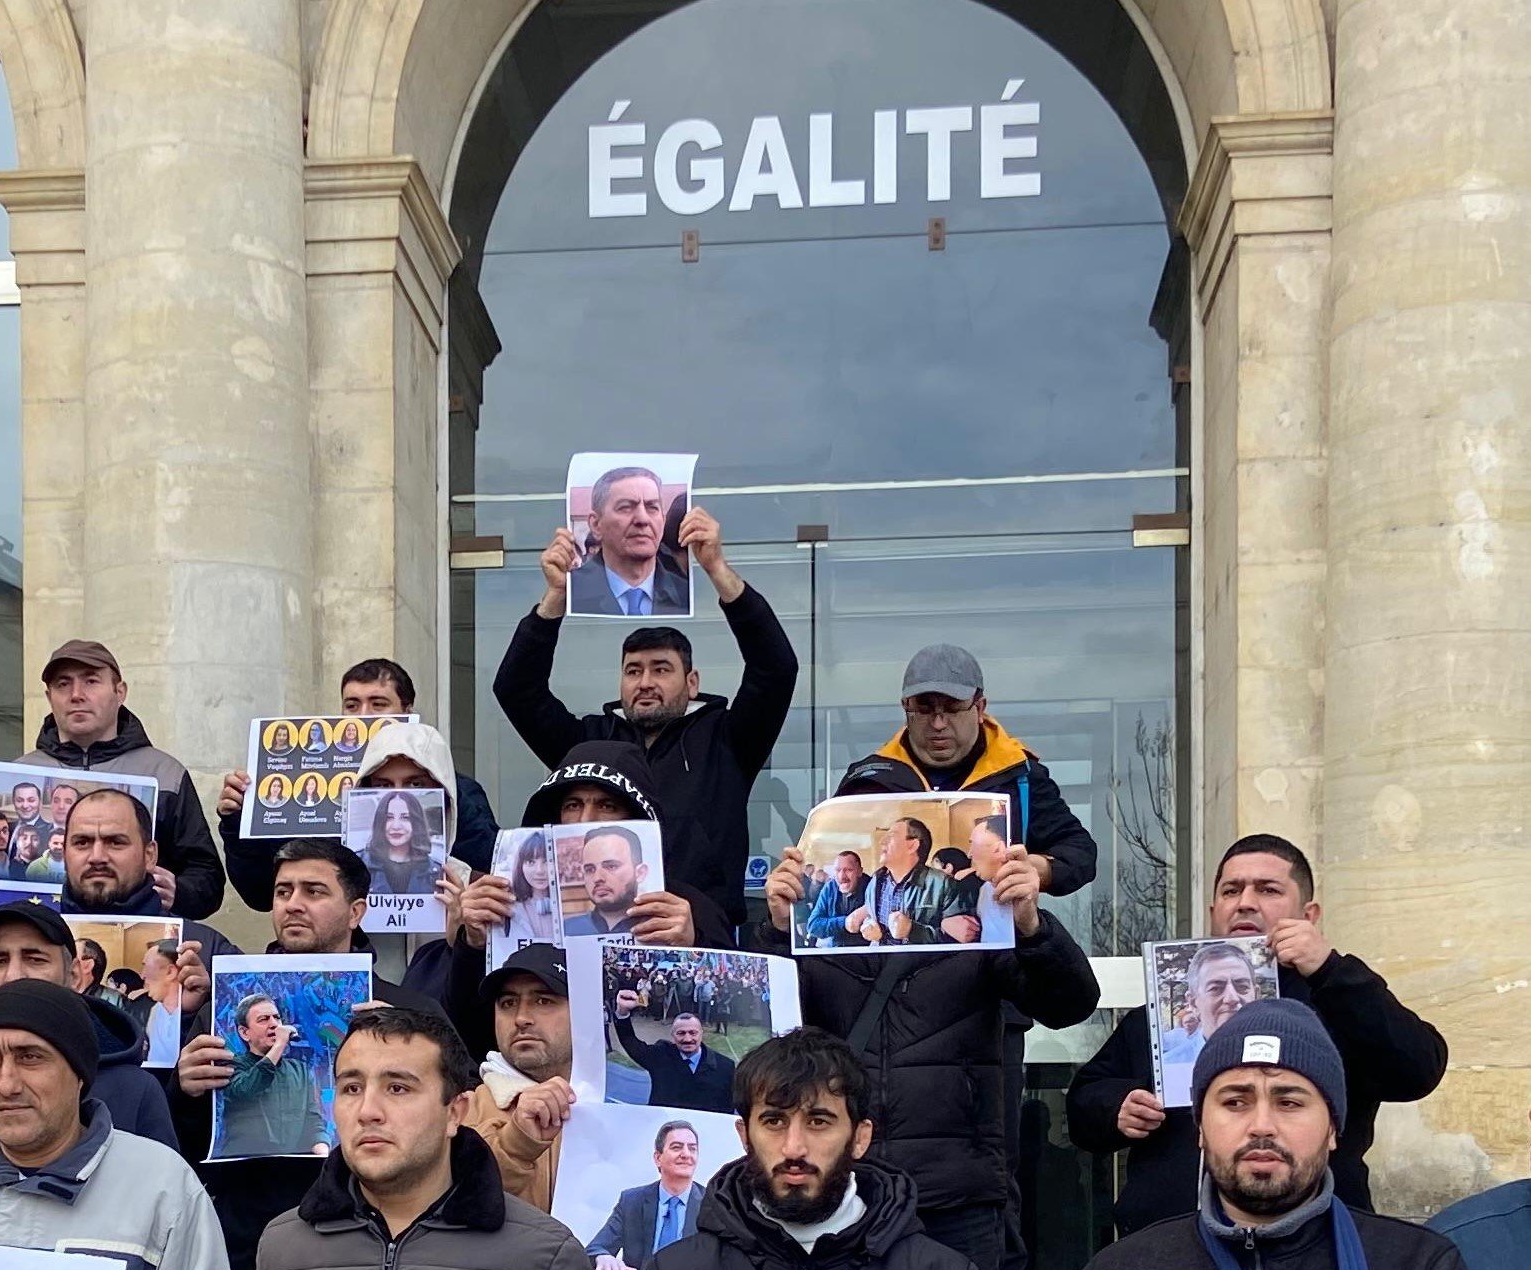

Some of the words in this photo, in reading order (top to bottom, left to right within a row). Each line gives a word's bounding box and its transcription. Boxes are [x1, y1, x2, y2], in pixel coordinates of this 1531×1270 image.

[588, 78, 1042, 218] ÉGALITÉ
[368, 895, 425, 911] Ulviyye
[386, 914, 406, 927] Ali
